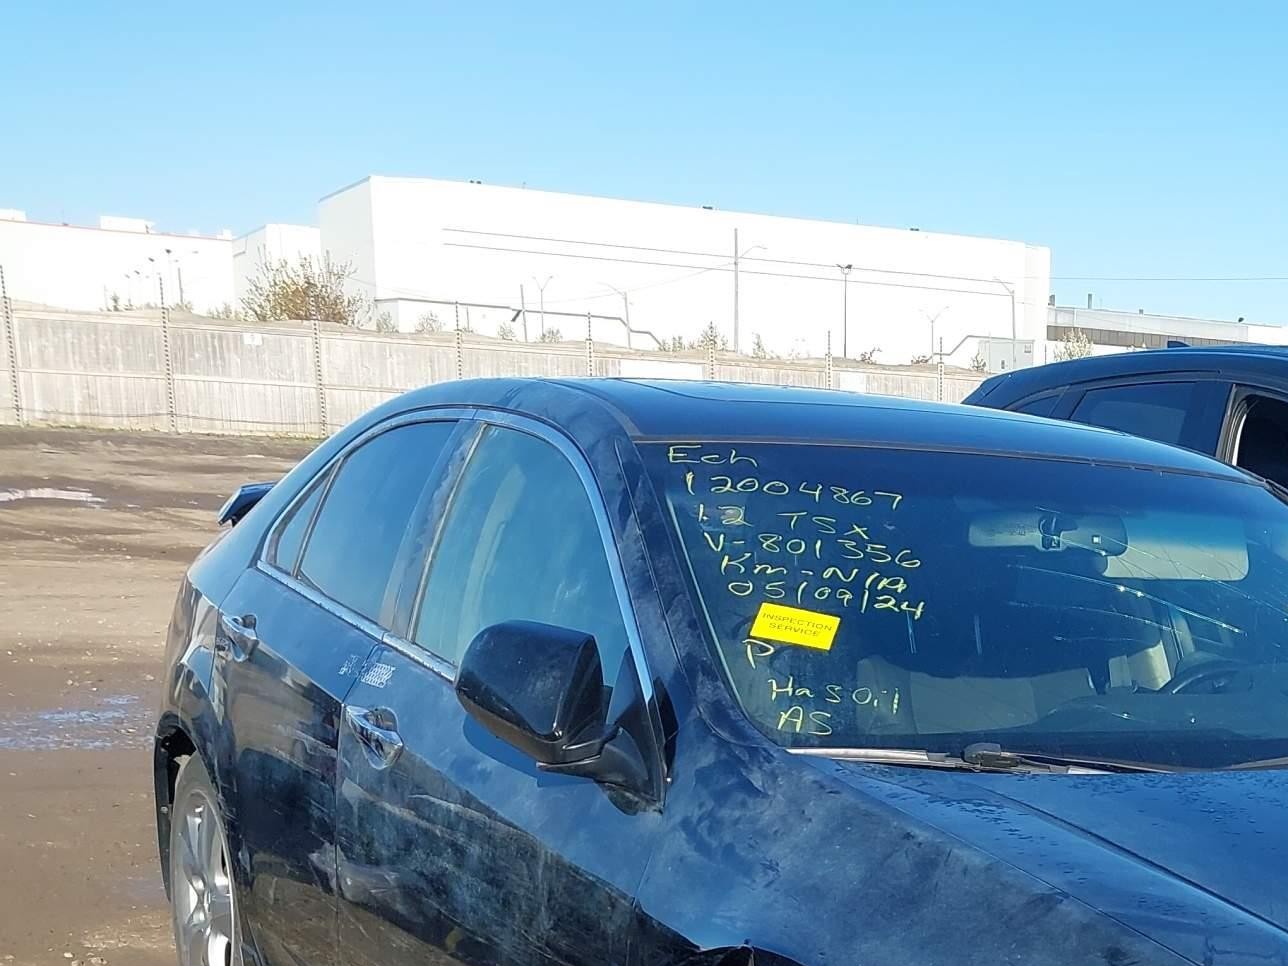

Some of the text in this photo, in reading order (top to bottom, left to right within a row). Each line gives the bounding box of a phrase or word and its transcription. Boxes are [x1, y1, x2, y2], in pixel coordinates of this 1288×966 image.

[685, 471, 903, 511] 12004867
[761, 612, 833, 632] INSPECTION
[768, 622, 822, 637] SERVICE
